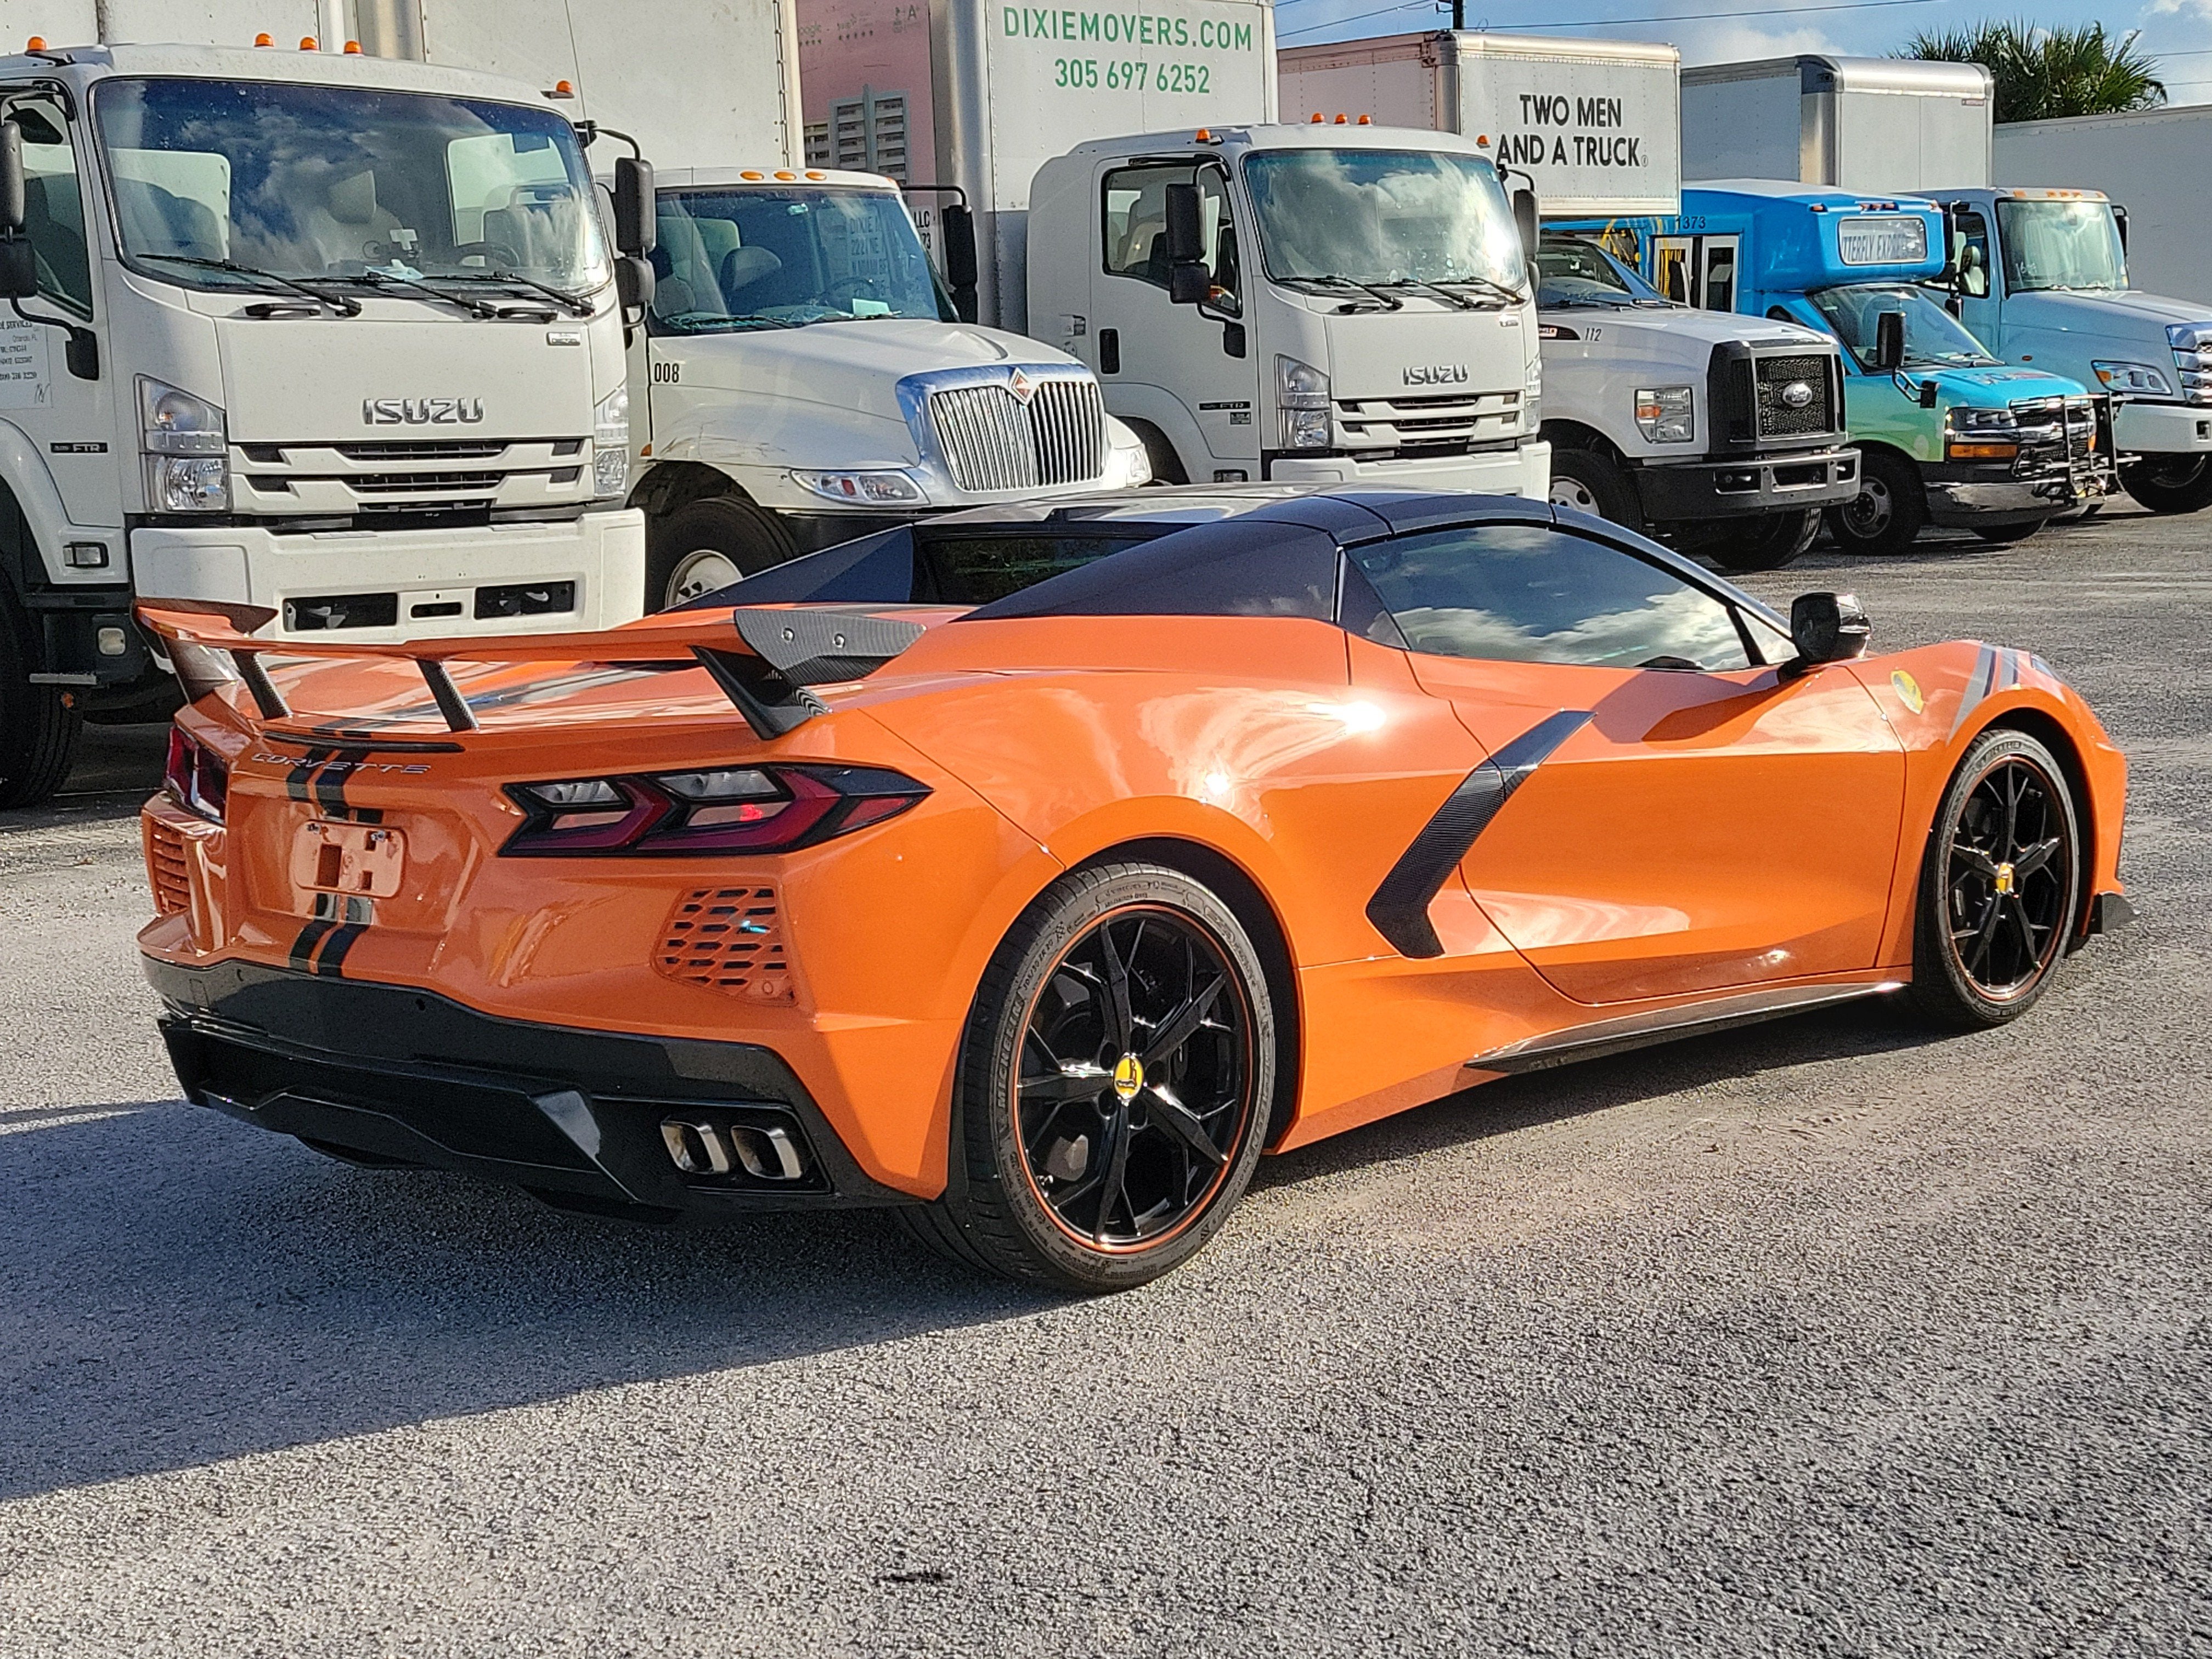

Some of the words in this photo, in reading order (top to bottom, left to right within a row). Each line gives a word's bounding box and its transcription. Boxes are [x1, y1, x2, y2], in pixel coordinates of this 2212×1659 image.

[1003, 6, 1252, 52] DIXIEMOVERS.COM
[1054, 58, 1098, 88] 305
[1107, 60, 1148, 91] 697
[1156, 63, 1210, 94] 6252
[1519, 94, 1570, 126] TWO
[1577, 97, 1622, 127] MEN
[1496, 133, 1545, 165] AND
[1551, 135, 1568, 166] A
[1573, 136, 1640, 167] TRUCK
[1675, 216, 1706, 229] 1373
[1584, 327, 1602, 342] 112
[654, 362, 680, 383] 008
[1402, 364, 1469, 386] ISUZU
[362, 397, 484, 425] ISUZU
[72, 443, 100, 452] FTR
[251, 753, 431, 775] CORVETTE
[997, 1000, 1025, 1109] MICHELIN
